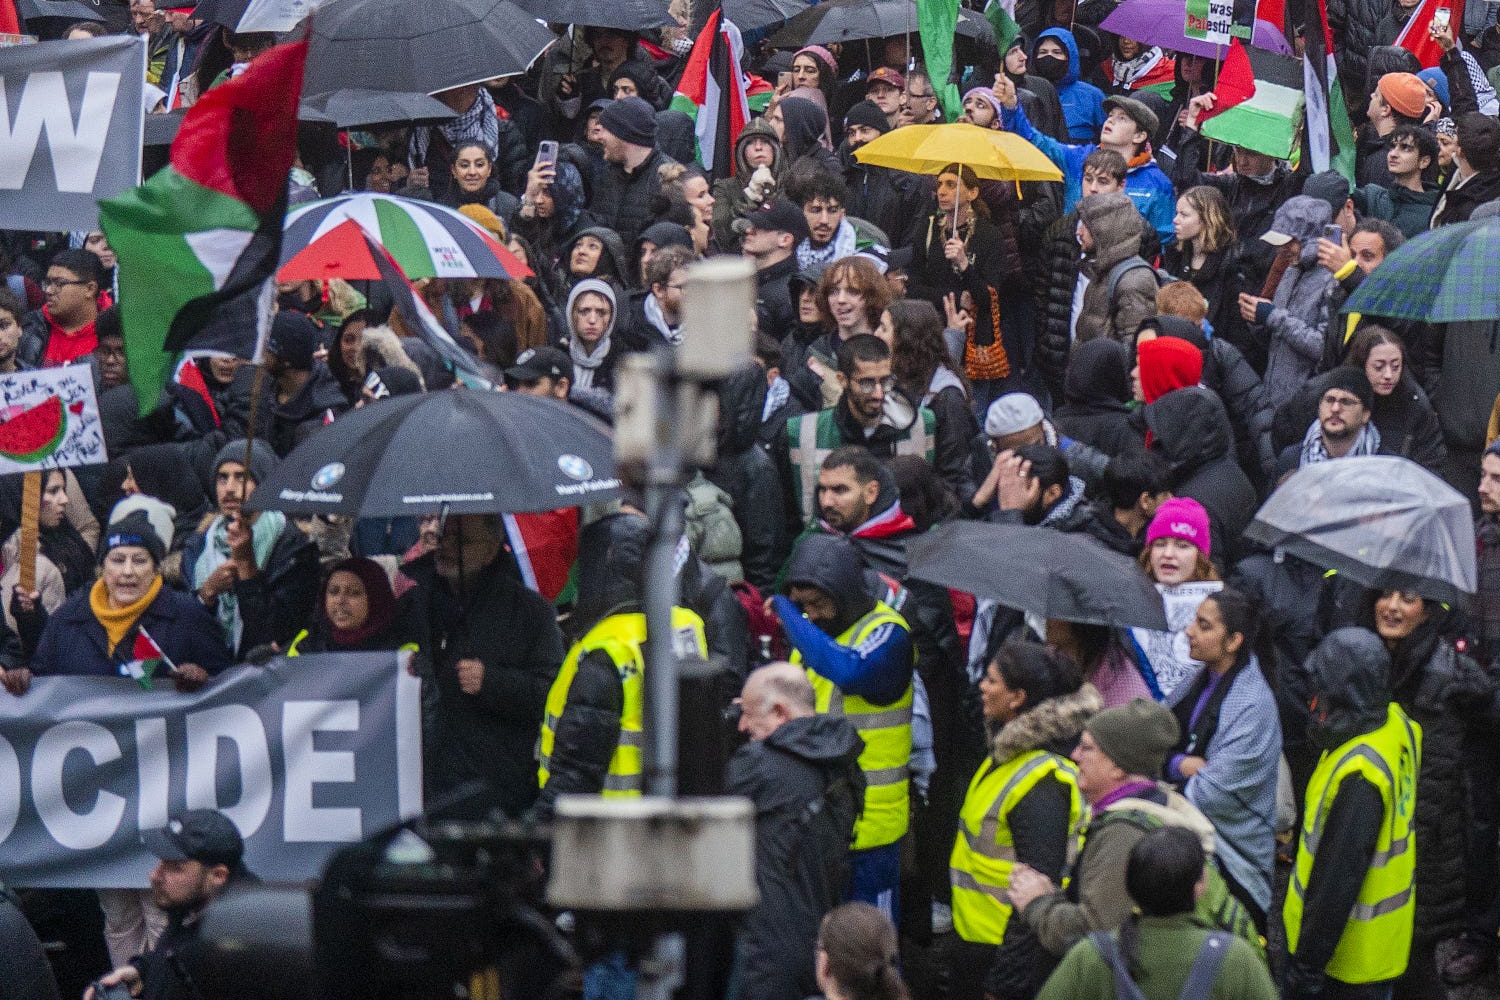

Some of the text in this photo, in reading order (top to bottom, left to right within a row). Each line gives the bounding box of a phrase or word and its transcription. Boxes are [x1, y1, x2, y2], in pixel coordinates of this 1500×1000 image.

[1210, 2, 1232, 17] was
[0, 71, 121, 194] W
[0, 699, 363, 851] CIDE
